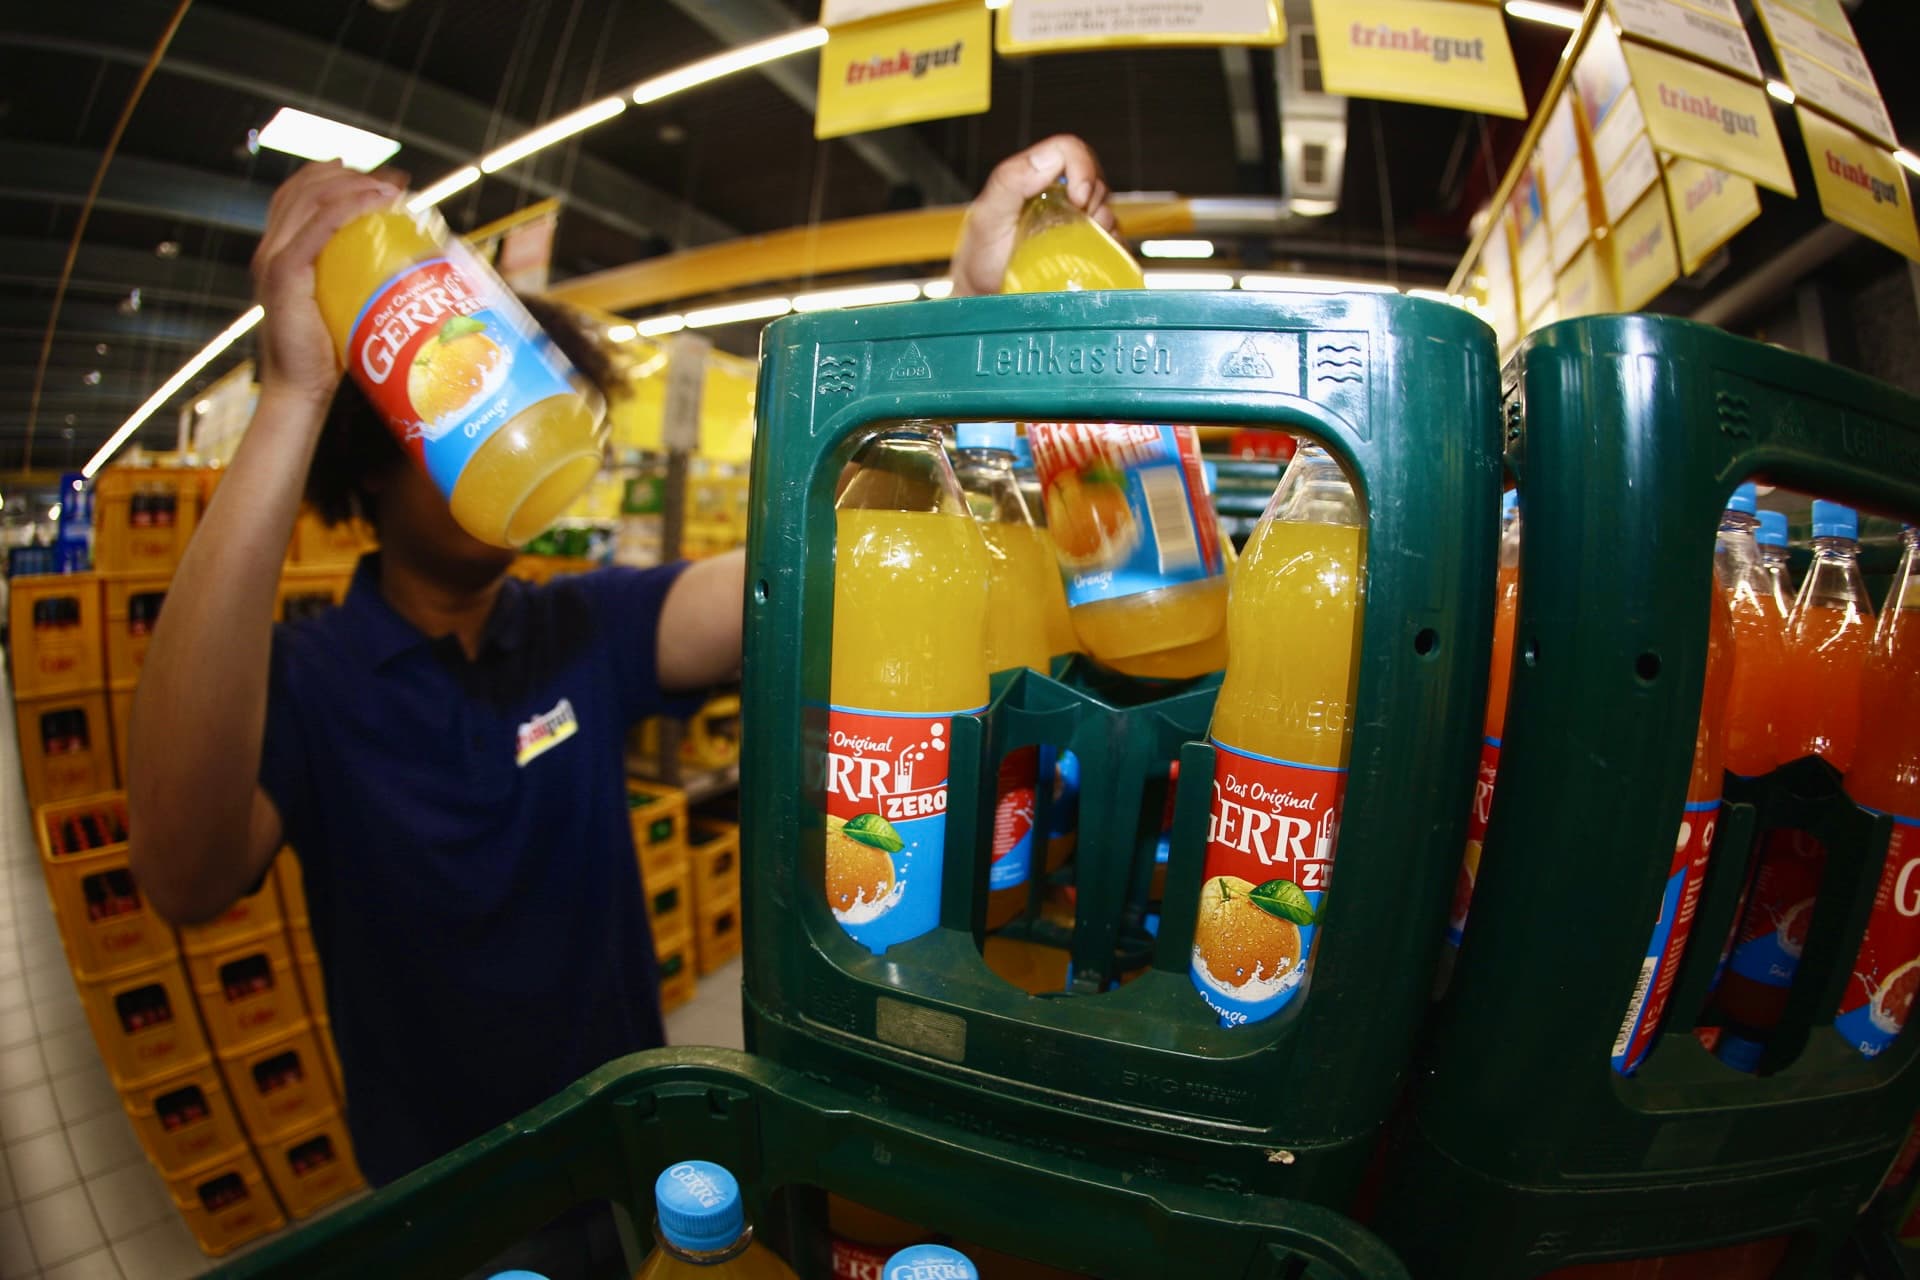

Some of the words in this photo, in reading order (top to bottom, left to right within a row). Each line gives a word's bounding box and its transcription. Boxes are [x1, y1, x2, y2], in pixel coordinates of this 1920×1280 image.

[1350, 23, 1486, 62] trinkgut
[846, 41, 964, 85] trinkgut
[1658, 82, 1759, 139] trinkgut
[1825, 149, 1899, 208] trinkgut
[975, 335, 1171, 377] Leihkasten
[464, 398, 510, 438] Orange
[833, 731, 894, 757] Original
[886, 790, 948, 819] ZERO
[1225, 774, 1248, 798] Das
[1251, 782, 1318, 814] Original
